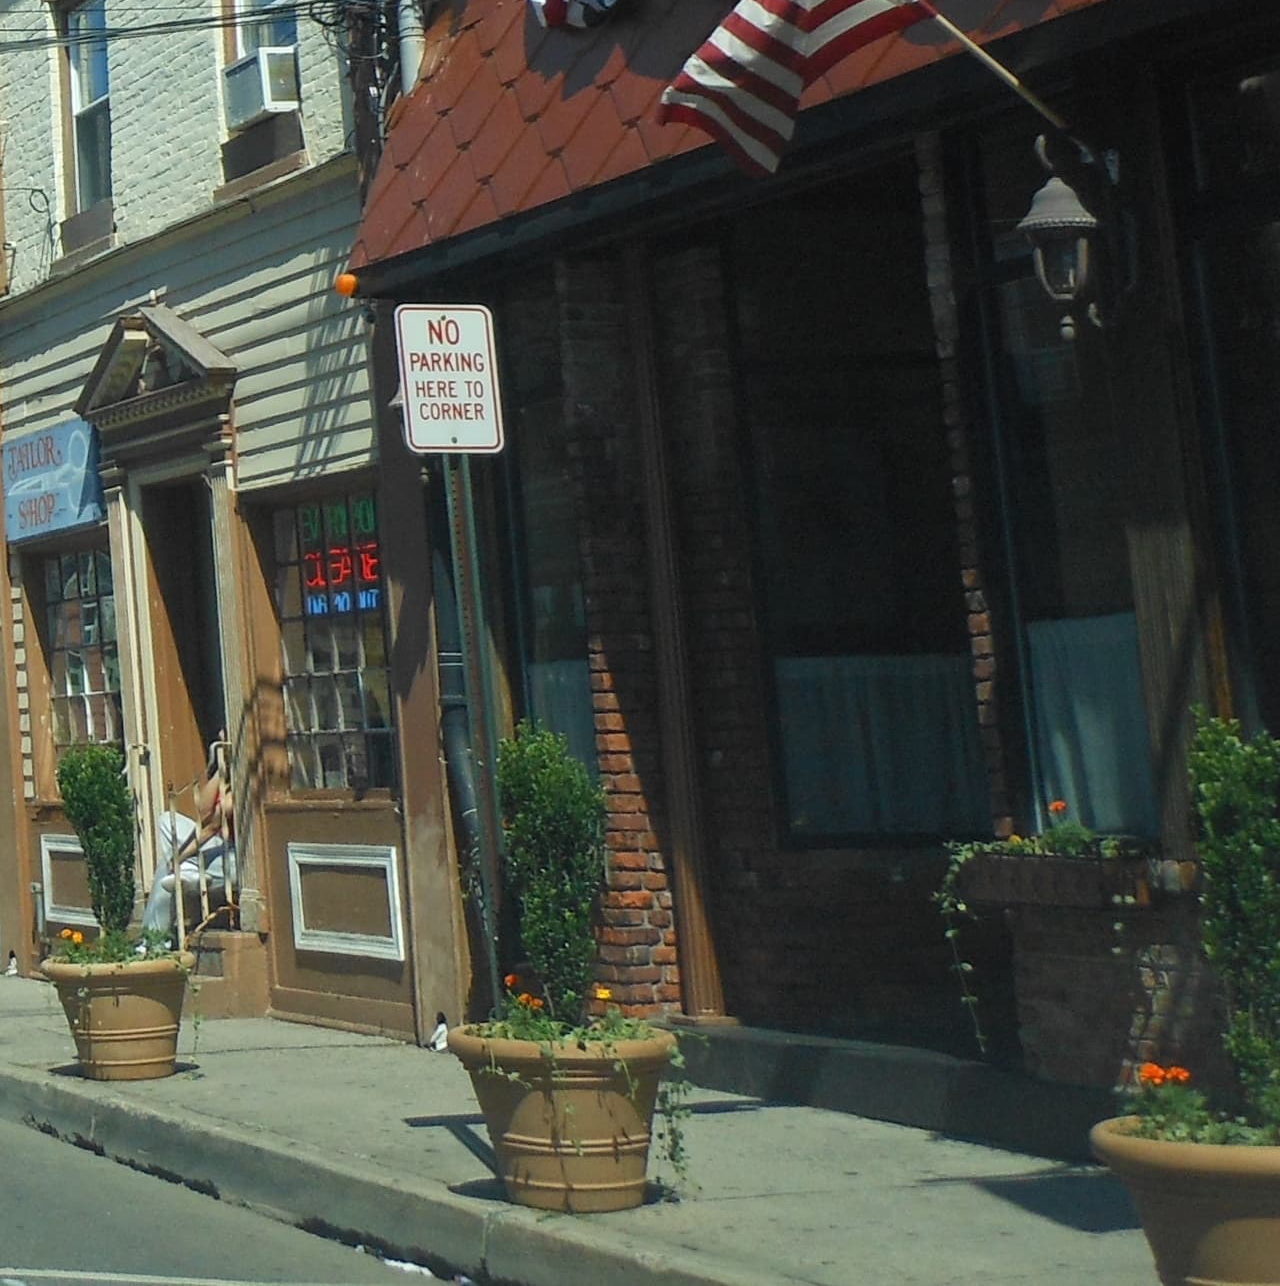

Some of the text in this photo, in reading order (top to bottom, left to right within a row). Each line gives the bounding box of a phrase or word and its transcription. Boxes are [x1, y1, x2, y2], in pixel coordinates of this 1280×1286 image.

[427, 319, 460, 345] NO
[409, 352, 485, 372] PARKING
[415, 380, 484, 398] HERE TO
[419, 402, 485, 420] CORNER
[8, 435, 62, 481] TAILOR
[18, 493, 56, 530] SHOP
